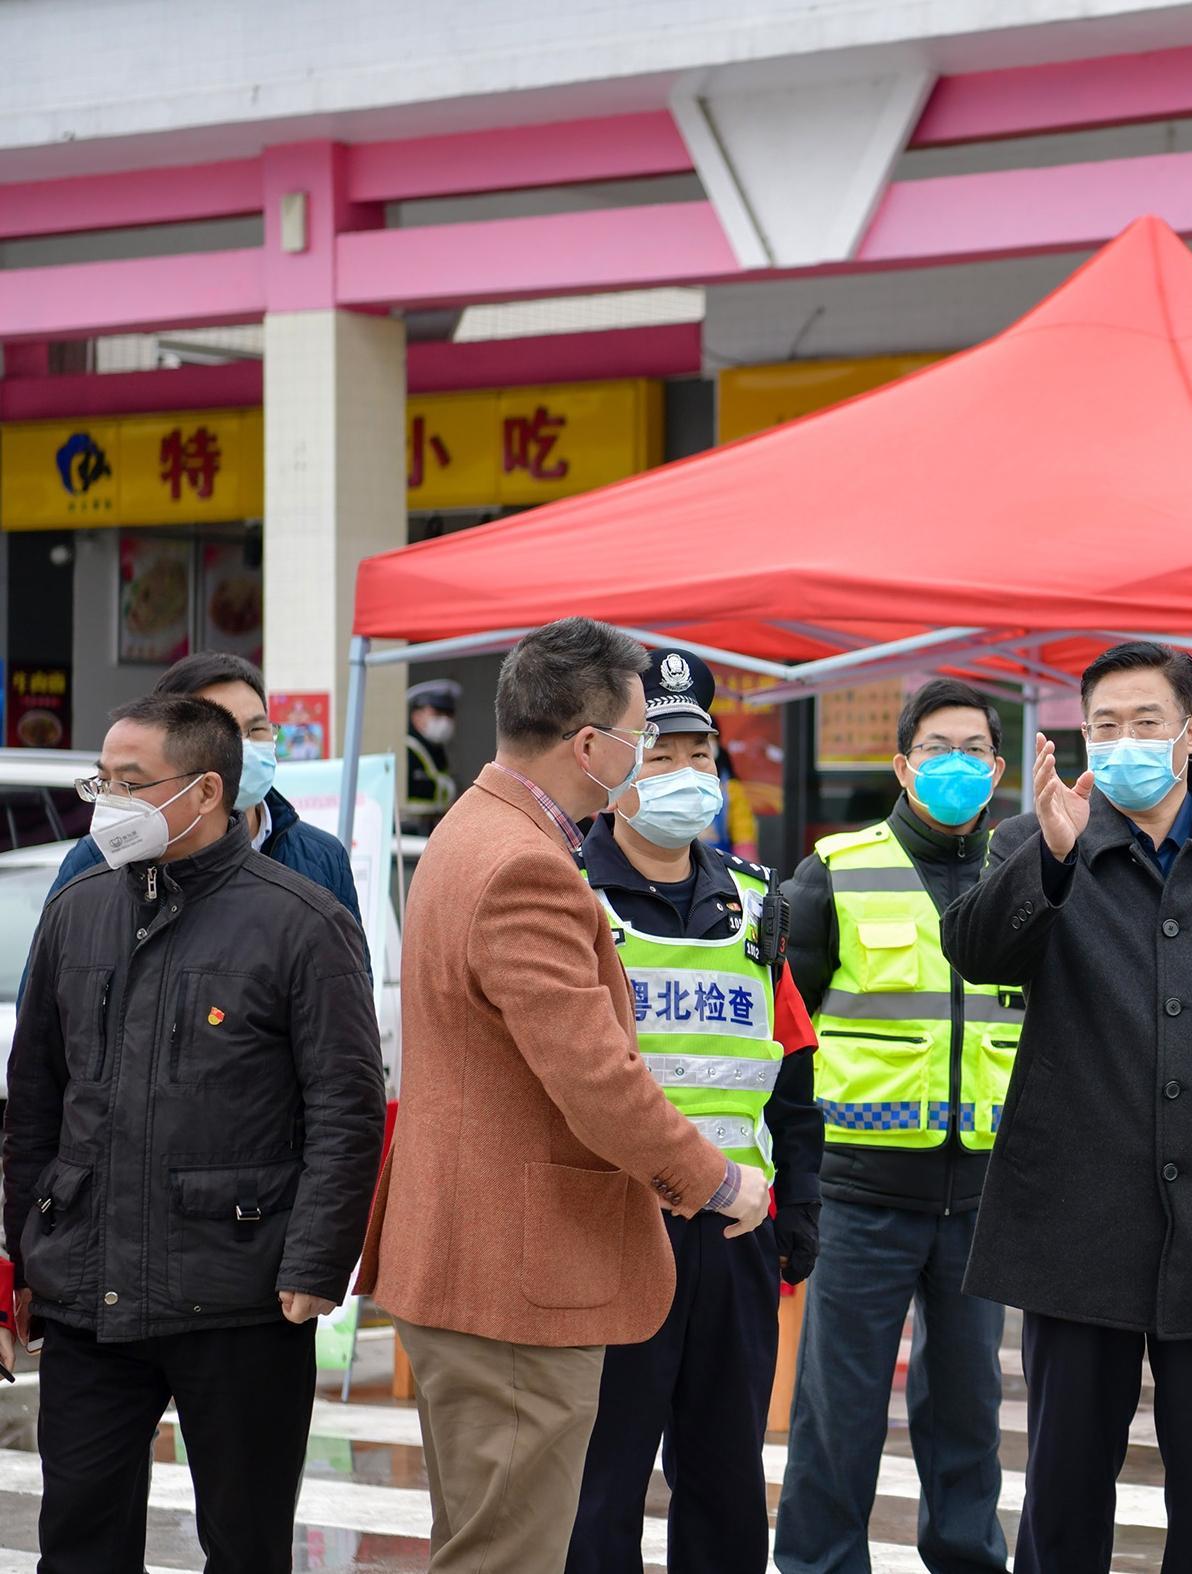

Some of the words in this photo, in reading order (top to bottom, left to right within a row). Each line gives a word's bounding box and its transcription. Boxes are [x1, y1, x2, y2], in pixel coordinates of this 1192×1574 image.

[159, 426, 222, 502] 特
[630, 978, 754, 1026] 粤北检查
